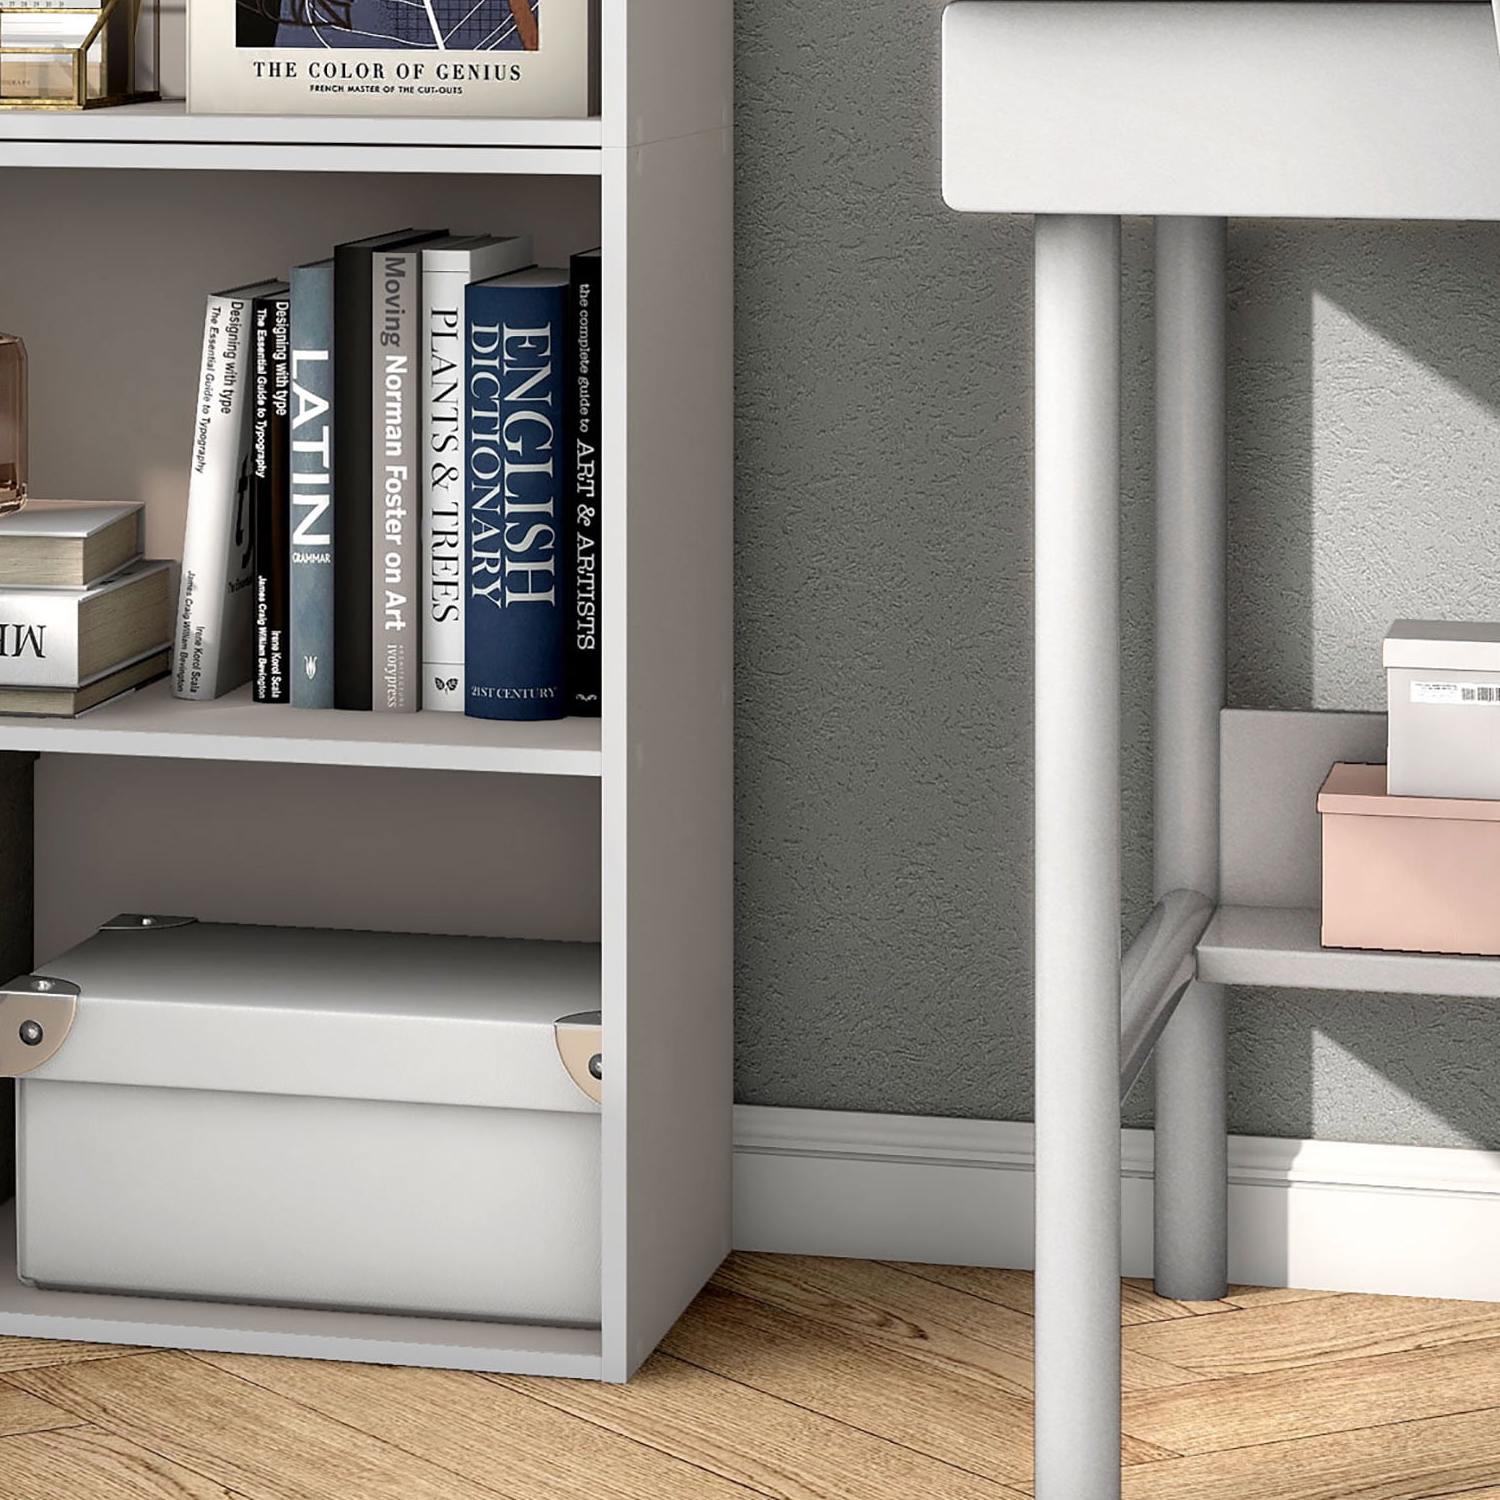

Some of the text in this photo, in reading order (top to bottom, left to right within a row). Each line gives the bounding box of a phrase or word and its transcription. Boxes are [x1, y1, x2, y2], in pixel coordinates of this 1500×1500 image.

[254, 61, 521, 81] THE COLOR OF GENIUS
[310, 85, 463, 94] FRENCH MASTER OF THE CUT-OUTS
[211, 306, 221, 324] The
[206, 327, 219, 372] Essential
[219, 301, 244, 415] Designing with type
[272, 301, 289, 416] Designing with type
[203, 372, 215, 402] Guide
[254, 308, 268, 478] The Essential Guide to Typography
[194, 417, 211, 474] Typography
[292, 349, 331, 546] LATIN
[380, 257, 408, 631] Moving Norman Foster on Art
[430, 306, 459, 623] PLANTS & TREES
[470, 322, 502, 609] DICTIONARY
[503, 322, 556, 608] ENGLISH
[576, 283, 595, 651] the complete guide to ART & ARTISTS
[292, 552, 331, 565] GRAMMAR
[182, 570, 196, 621] James Craig
[258, 575, 267, 602] James
[257, 603, 267, 626] Craig
[271, 652, 281, 675] Korol
[271, 676, 281, 698] Scala
[384, 644, 397, 708] ivorypress
[496, 687, 555, 699] CENTURY
